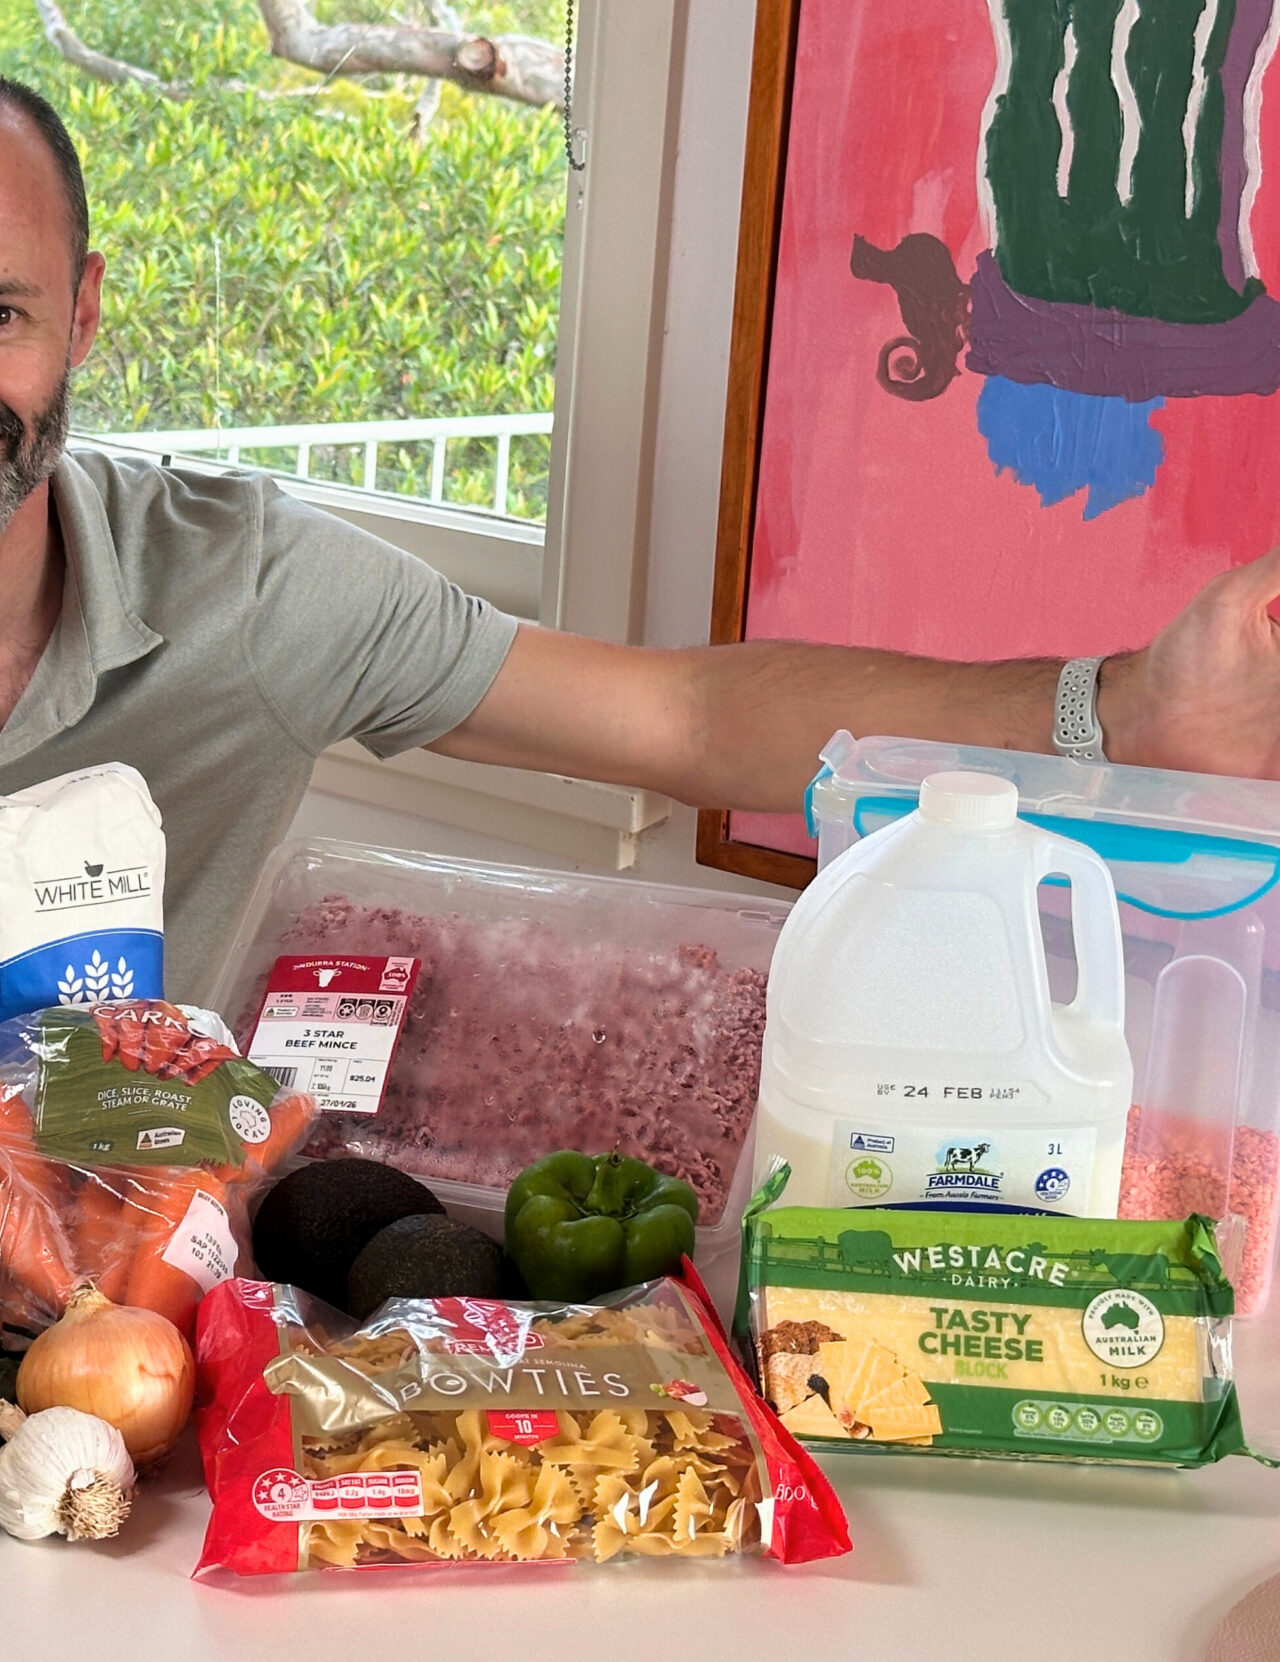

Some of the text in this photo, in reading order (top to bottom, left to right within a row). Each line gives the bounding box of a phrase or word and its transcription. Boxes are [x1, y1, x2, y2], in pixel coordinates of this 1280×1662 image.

[34, 873, 151, 906] WHITE MILL
[335, 960, 369, 972] STATION
[303, 1029, 345, 1039] 3 STAR
[285, 1039, 358, 1050] BEEF MINCE
[97, 1086, 193, 1106] DICE, SLICE, ROAST,
[903, 1085, 983, 1100] 24 FEB
[101, 1096, 189, 1112] STEAM OR GRATE
[232, 1099, 267, 1124] LOVING
[231, 1115, 266, 1139] LOCAL
[98, 1142, 111, 1151] kg
[927, 1175, 1001, 1189] FARMDALE
[1049, 1181, 1055, 1189] 4
[924, 1191, 1000, 1200] From Aussie Farmers
[190, 1235, 208, 1250] SAP
[892, 1245, 1070, 1287] WESTACRE
[951, 1273, 1011, 1289] DAIRY
[1088, 1293, 1154, 1320] PROUDLY MADE WITH
[929, 1307, 1032, 1336] TASTY
[918, 1331, 1044, 1363] CHEESE
[1095, 1335, 1157, 1344] AUSTRALIAN
[1109, 1345, 1146, 1357] MILK
[534, 1359, 587, 1371] SEMOLINA
[954, 1359, 1009, 1380] BLOCK
[399, 1368, 630, 1402] BOWTIES
[1100, 1374, 1107, 1387] 1
[1111, 1374, 1131, 1390] kg
[515, 1419, 532, 1434] 10
[277, 1487, 286, 1500] 4
[264, 1504, 285, 1512] HEALTH
